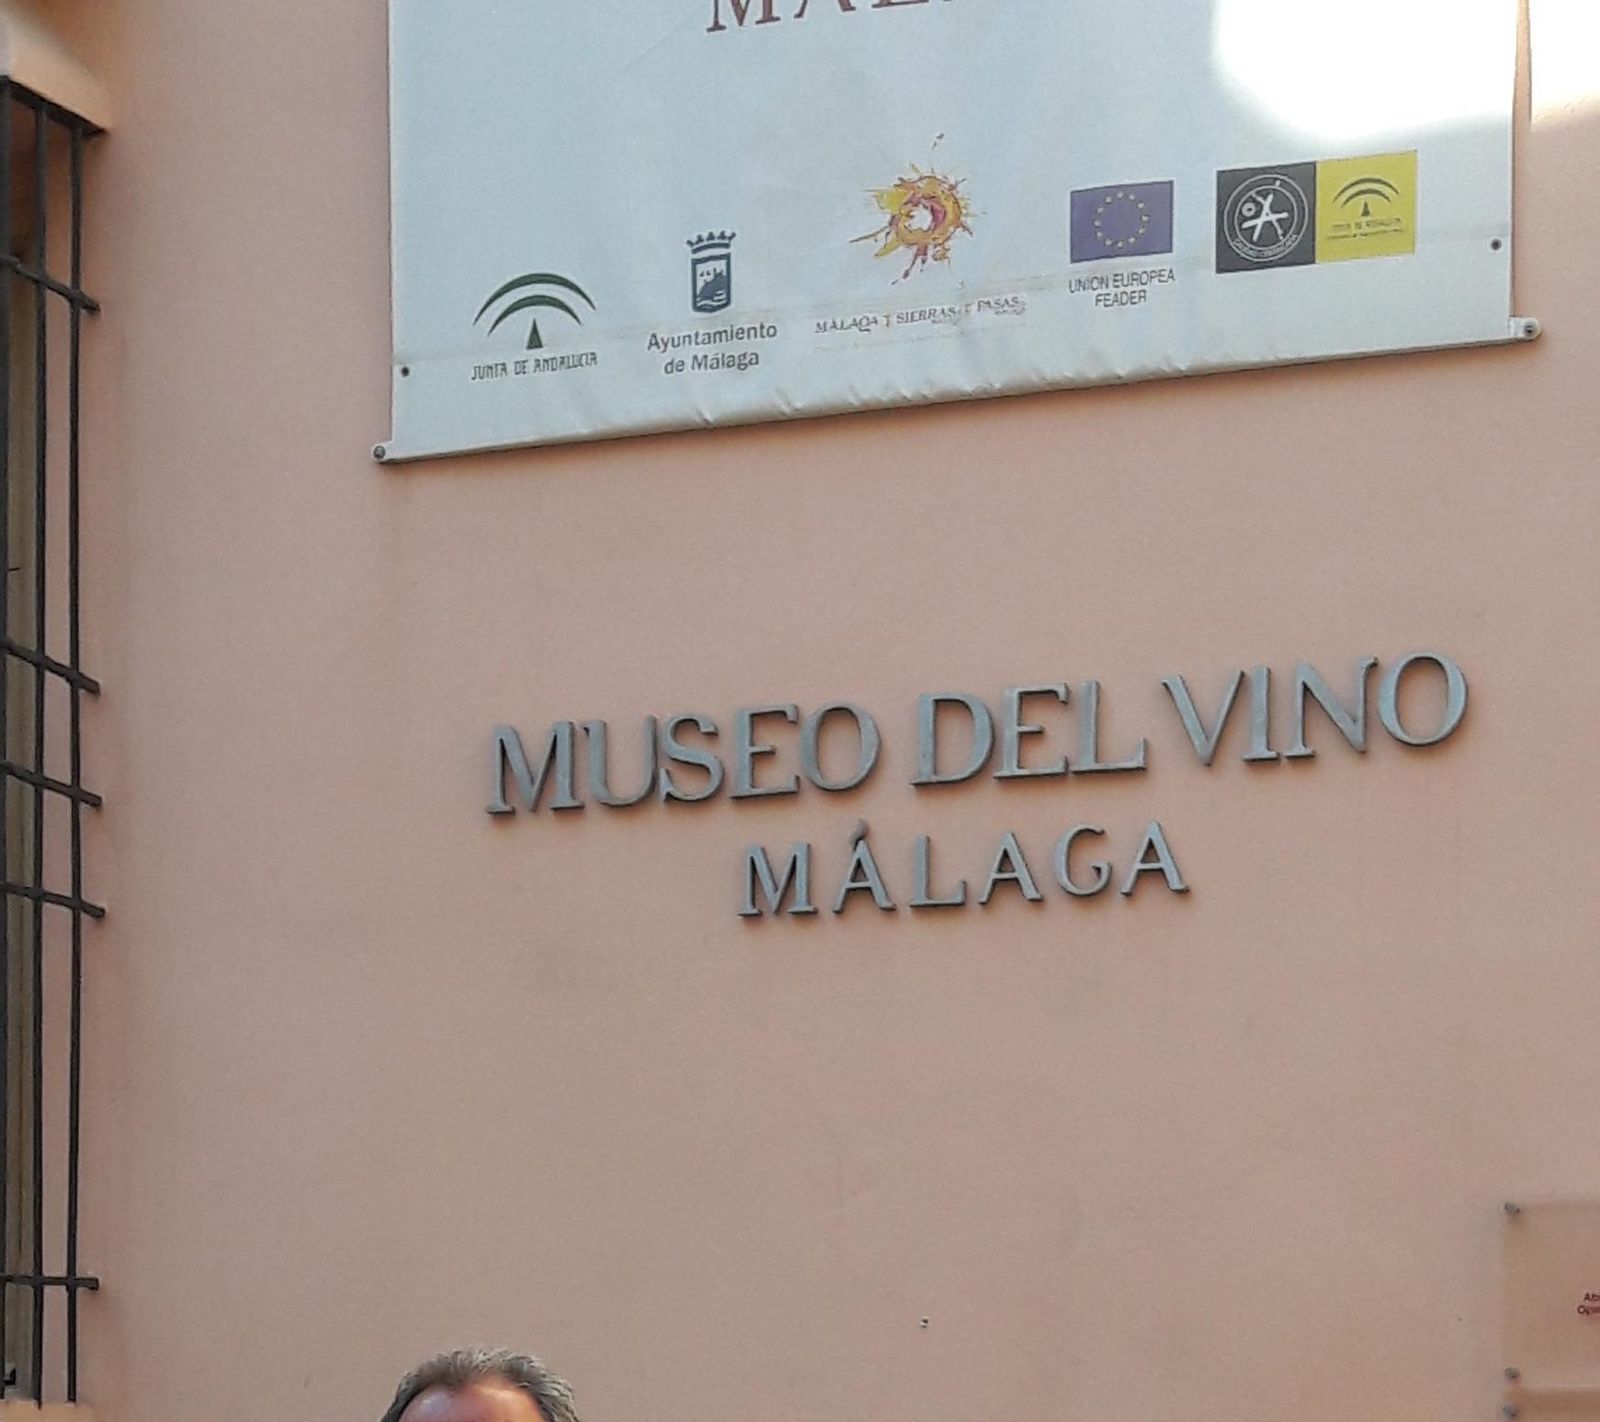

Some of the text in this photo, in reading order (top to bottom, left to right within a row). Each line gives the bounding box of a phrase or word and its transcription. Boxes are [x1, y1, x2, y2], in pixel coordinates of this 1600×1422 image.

[1069, 268, 1176, 293] UNION EUROPEA
[1094, 289, 1147, 307] FEADER
[896, 306, 957, 325] SIERRAS
[646, 321, 778, 353] Ayuntamiento
[471, 351, 599, 381] JUNTA DE ANDALUCIA
[663, 350, 760, 375] de Málaga
[485, 651, 1470, 818] MUSEO DEL VINO
[736, 816, 1192, 918] MÁLAGA
